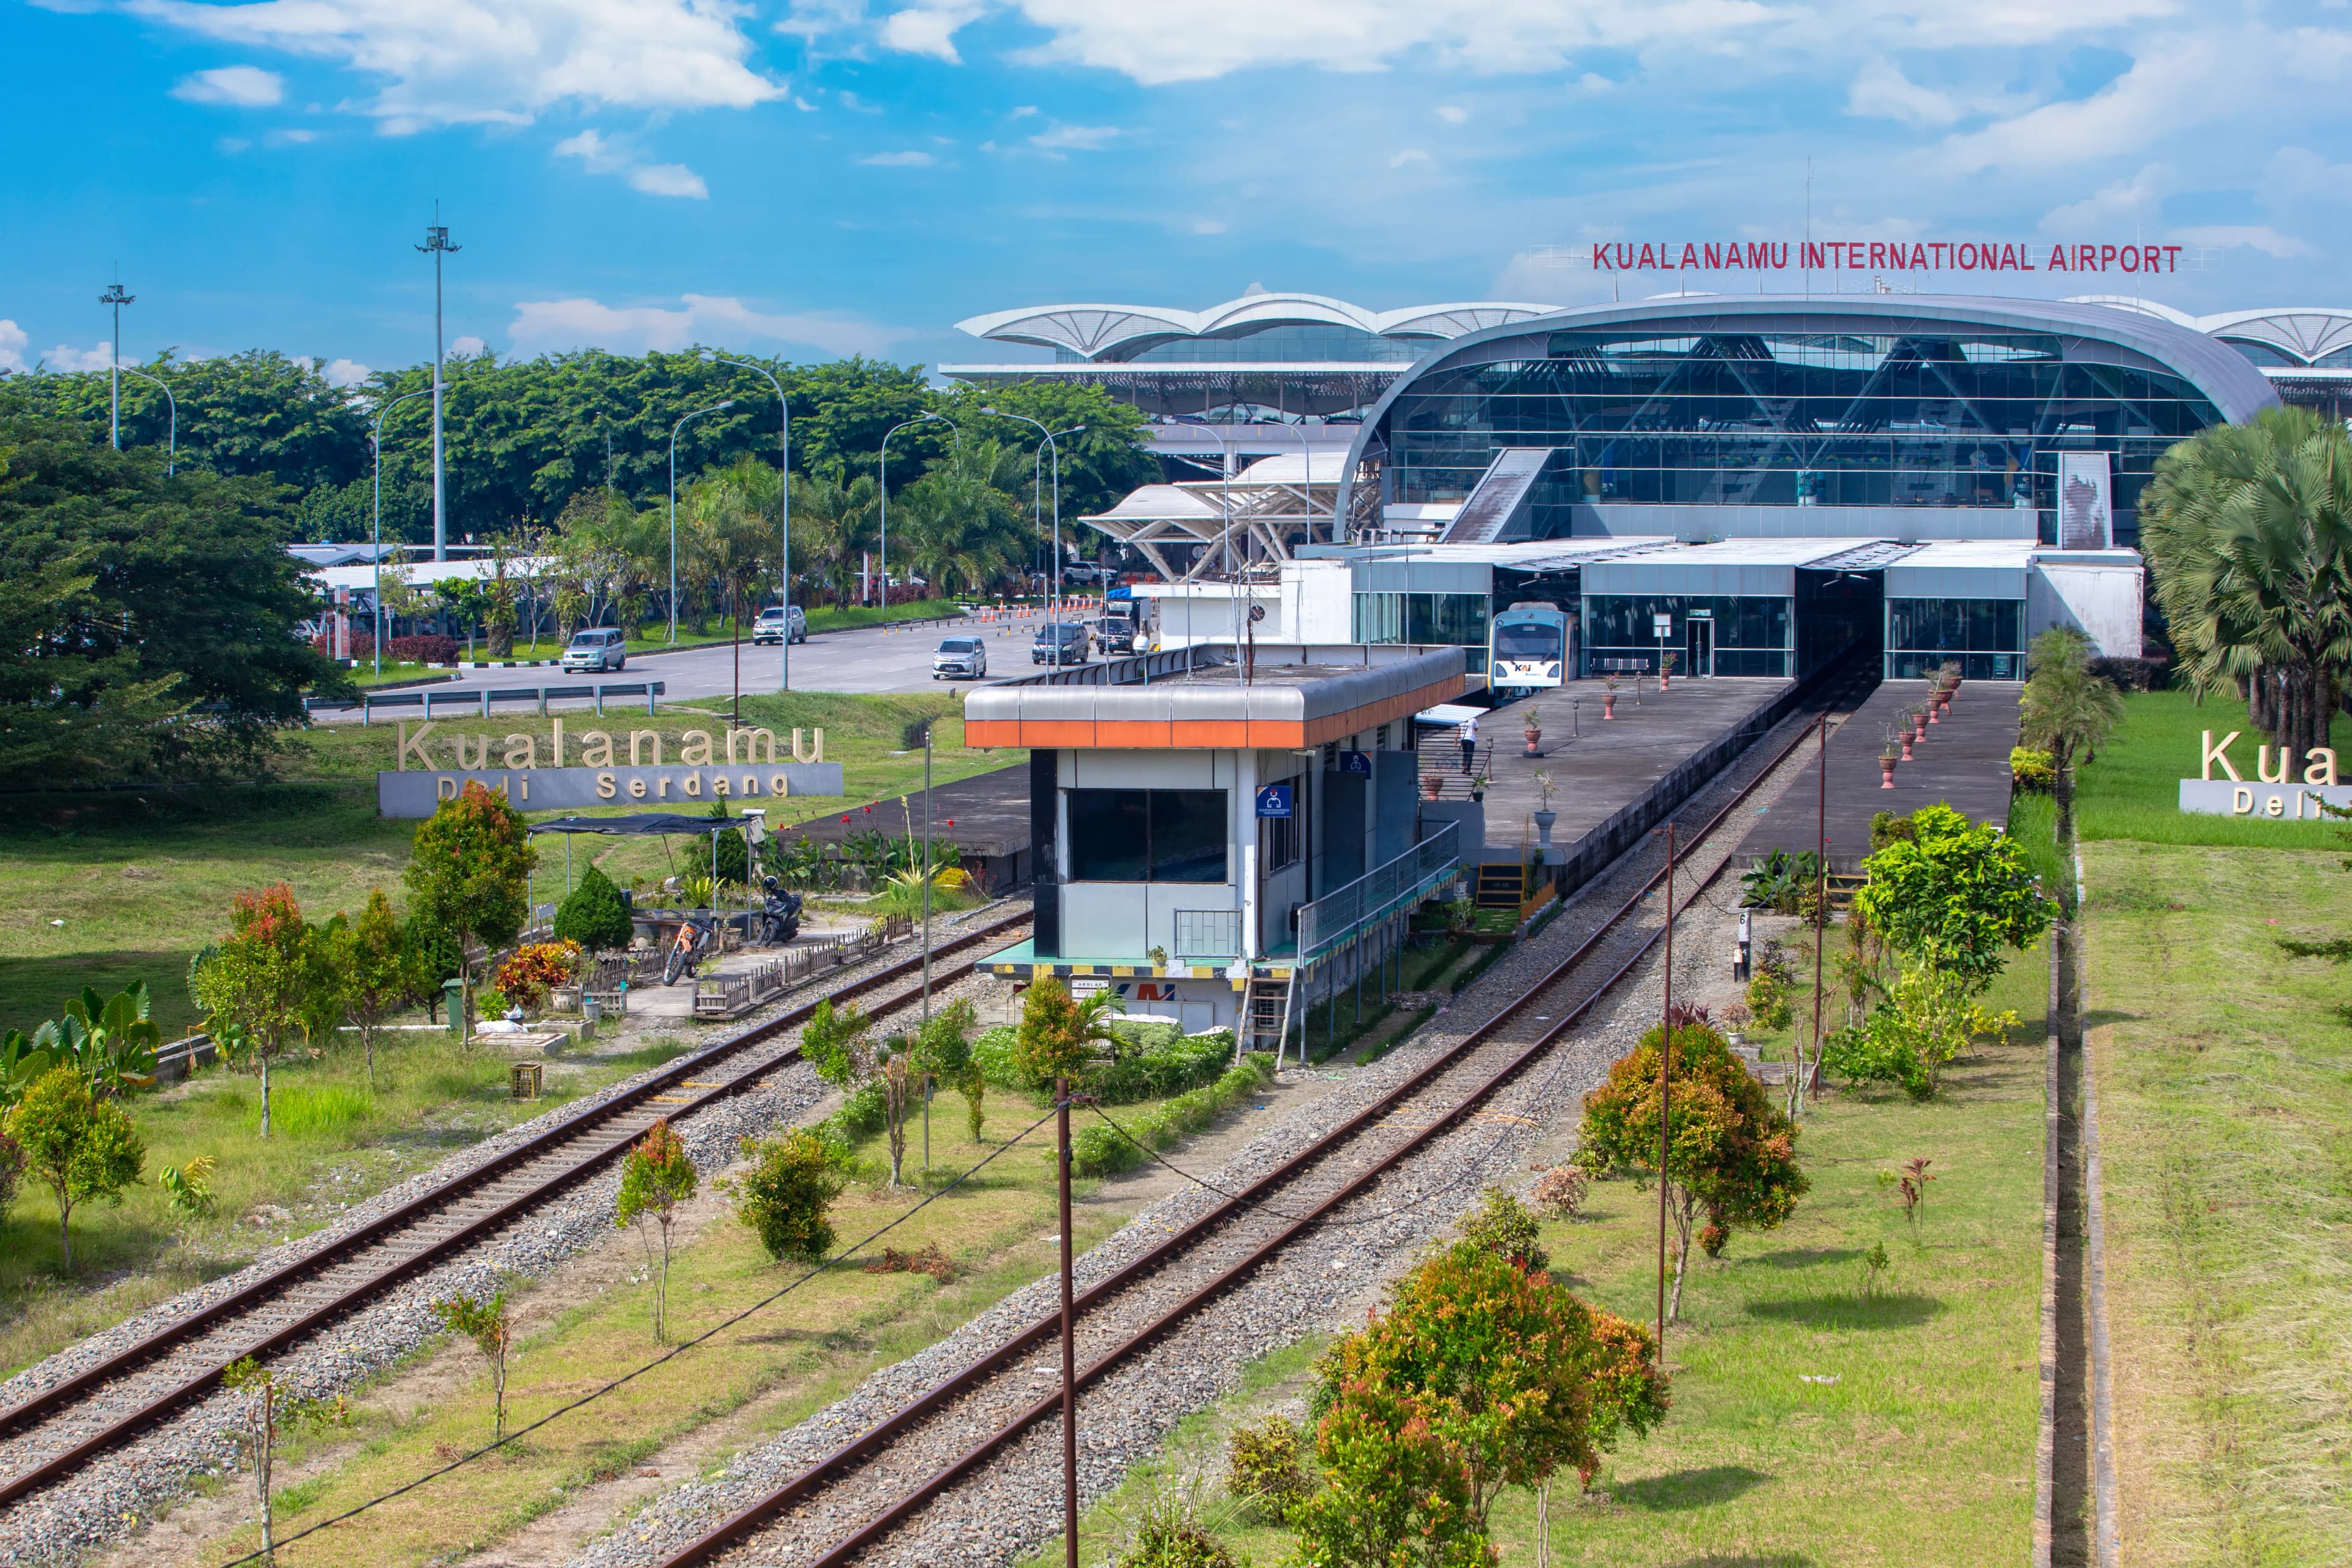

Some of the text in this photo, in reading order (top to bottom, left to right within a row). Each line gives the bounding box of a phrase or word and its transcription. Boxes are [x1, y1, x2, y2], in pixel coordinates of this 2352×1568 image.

[1593, 242, 2182, 273] KUALANAMU INTERNATIONAL AIRPORT
[397, 718, 824, 772] Kualanamu
[2201, 729, 2338, 786] Kua
[596, 771, 789, 798] Serdang
[2233, 787, 2323, 819] Deli
[1740, 914, 1745, 924] 6
